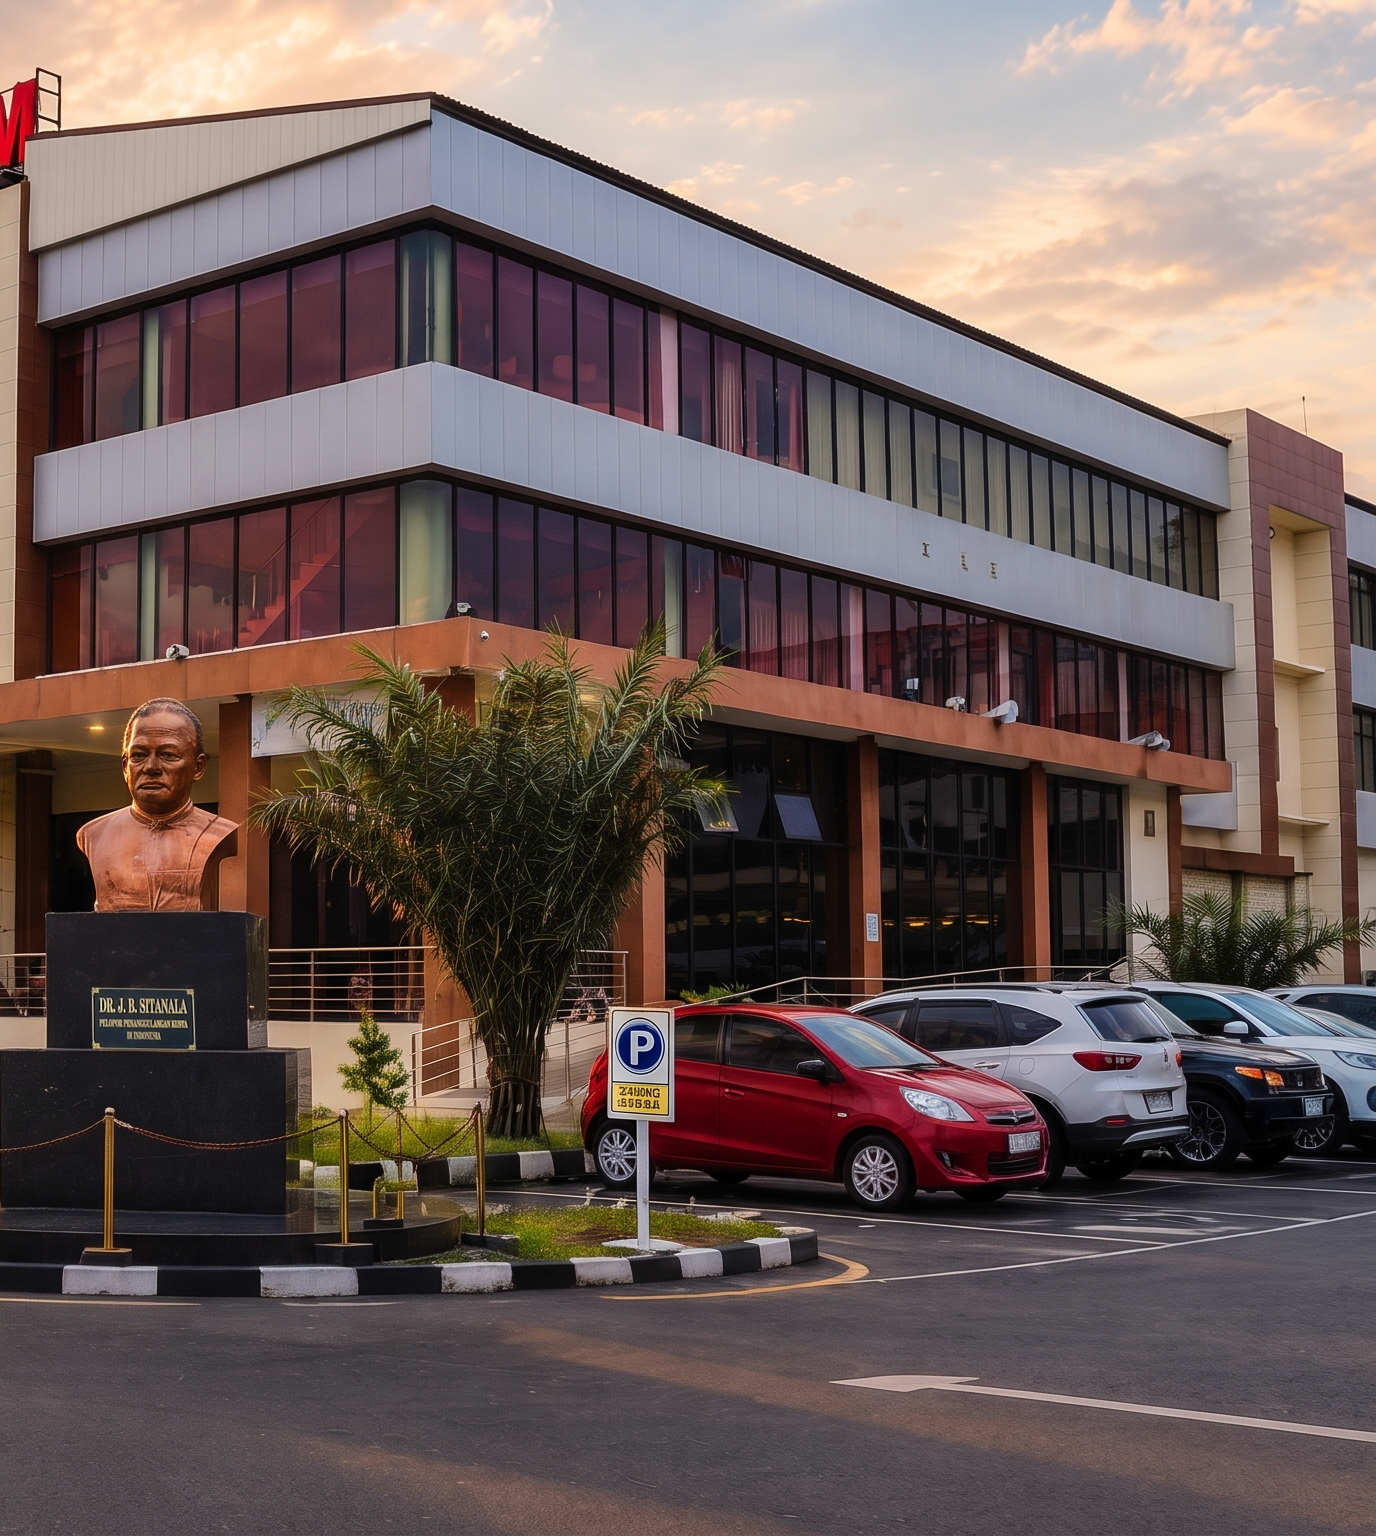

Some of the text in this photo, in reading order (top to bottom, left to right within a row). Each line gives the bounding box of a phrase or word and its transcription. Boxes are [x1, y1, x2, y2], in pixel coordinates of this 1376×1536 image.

[99, 997, 188, 1015] DR. J. B. SITANALA
[630, 1030, 655, 1066] P
